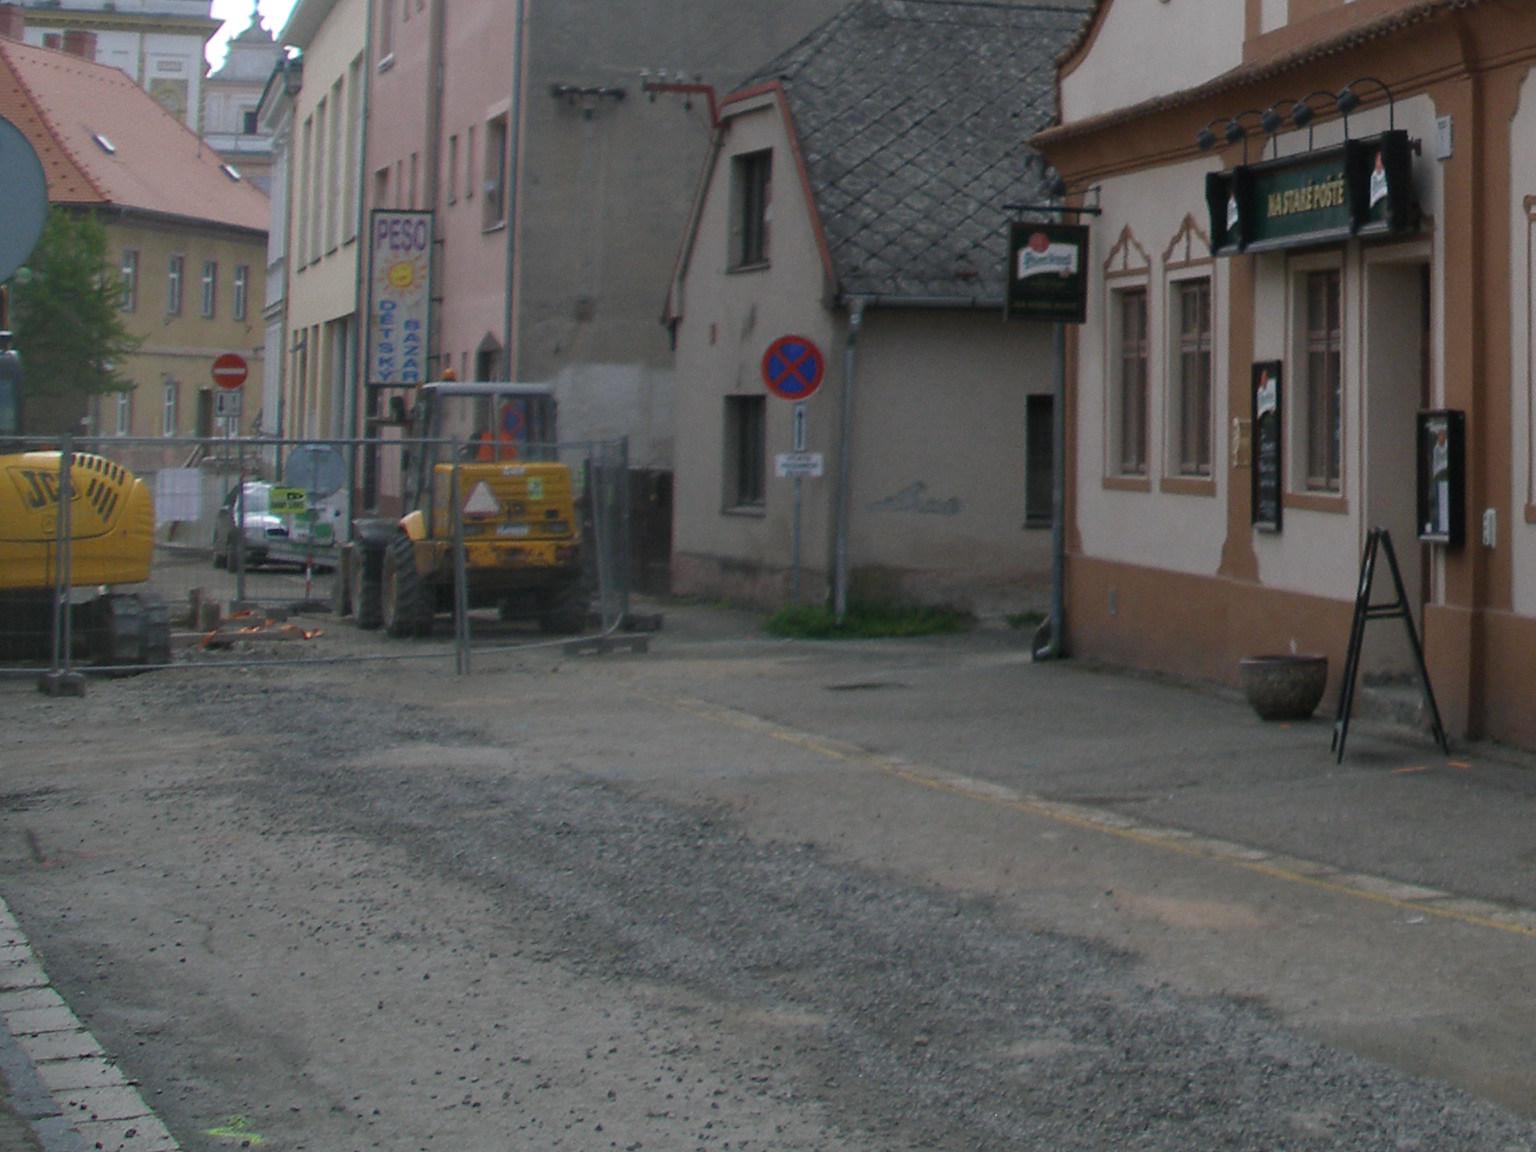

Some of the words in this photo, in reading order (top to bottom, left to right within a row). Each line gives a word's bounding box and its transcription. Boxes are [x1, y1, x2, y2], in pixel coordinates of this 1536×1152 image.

[1267, 191, 1283, 218] NA
[376, 219, 427, 251] PESO
[401, 319, 420, 383] BAZAR
